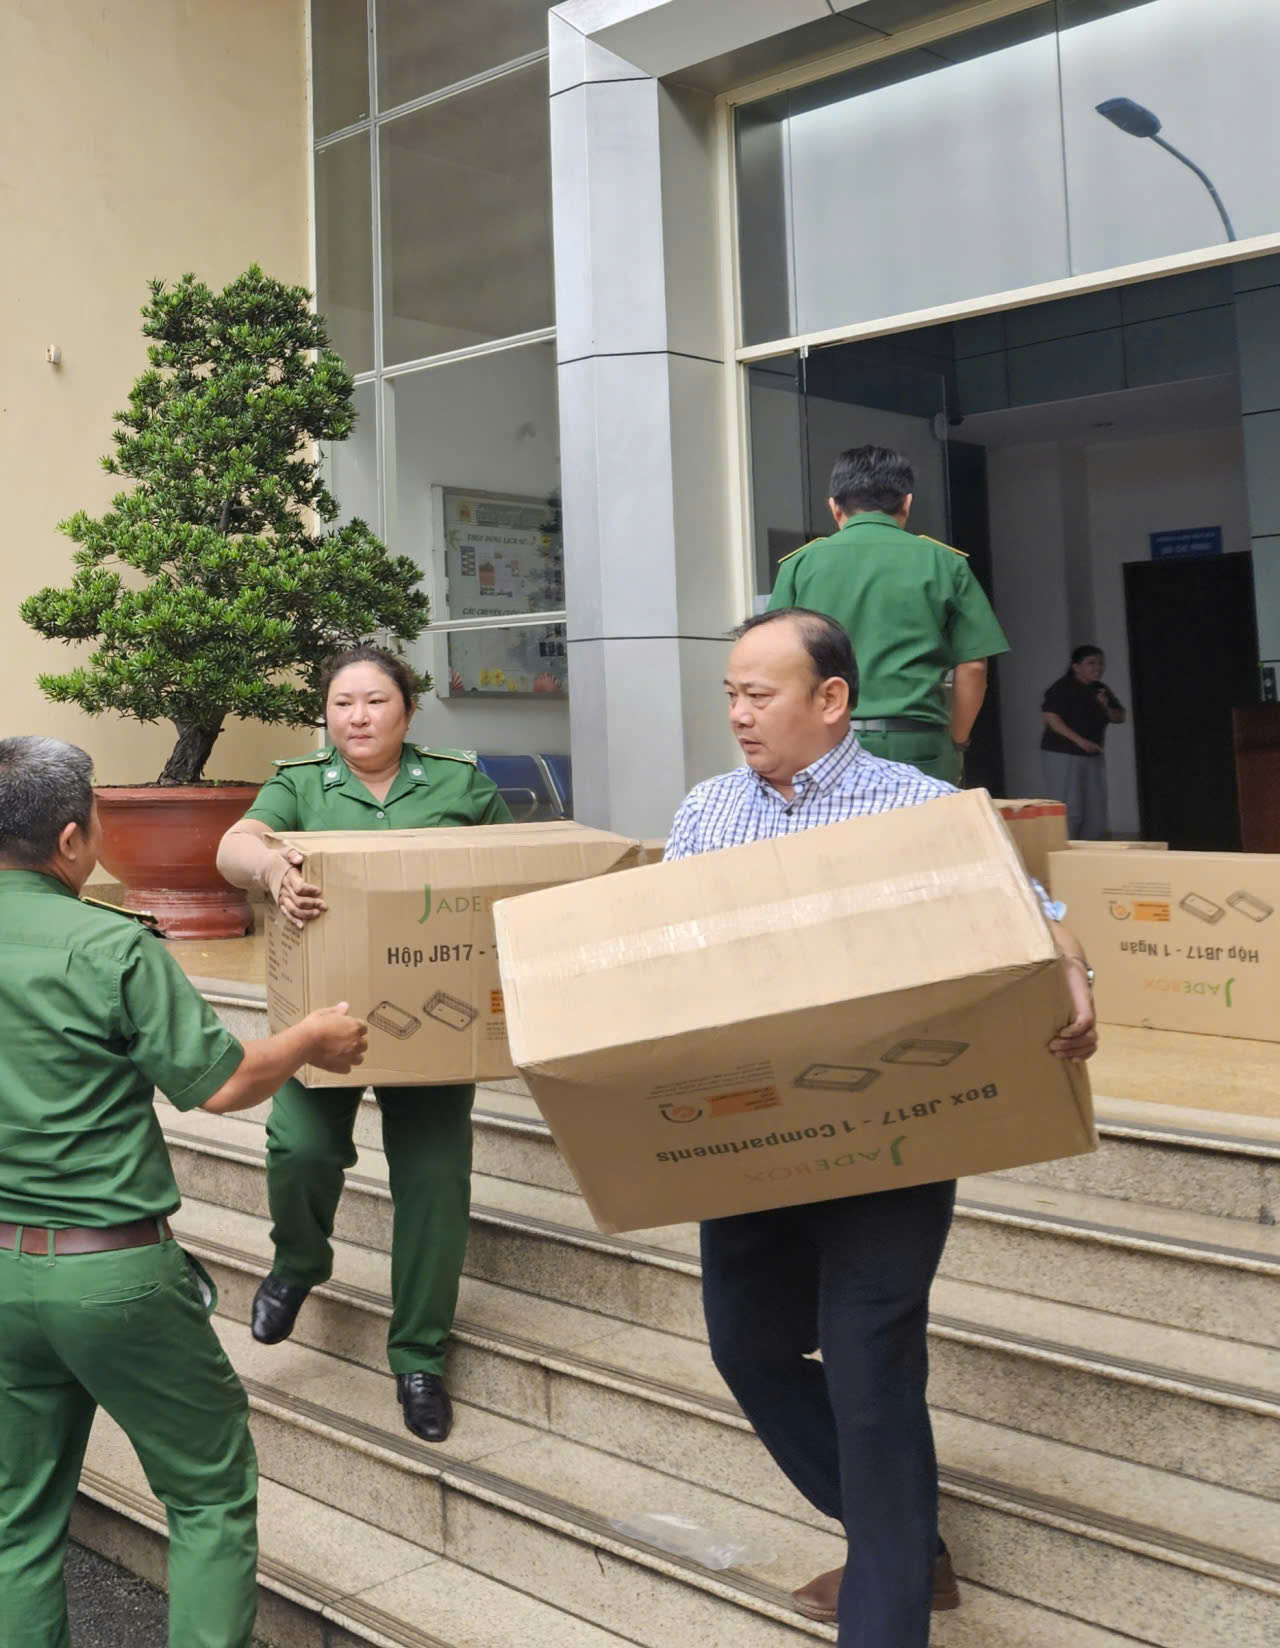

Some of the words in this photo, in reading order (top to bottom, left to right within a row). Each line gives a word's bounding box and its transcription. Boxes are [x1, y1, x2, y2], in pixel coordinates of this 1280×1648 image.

[388, 947, 423, 968] Hộp
[429, 944, 472, 962] JB17
[1186, 945, 1223, 961] JB17
[1228, 947, 1259, 963] Hộp
[951, 1082, 998, 1110] Box
[882, 1098, 942, 1126] JB17
[842, 1118, 857, 1135] 1
[656, 1123, 836, 1164] Compartments
[744, 1135, 908, 1185] JADEBOX
